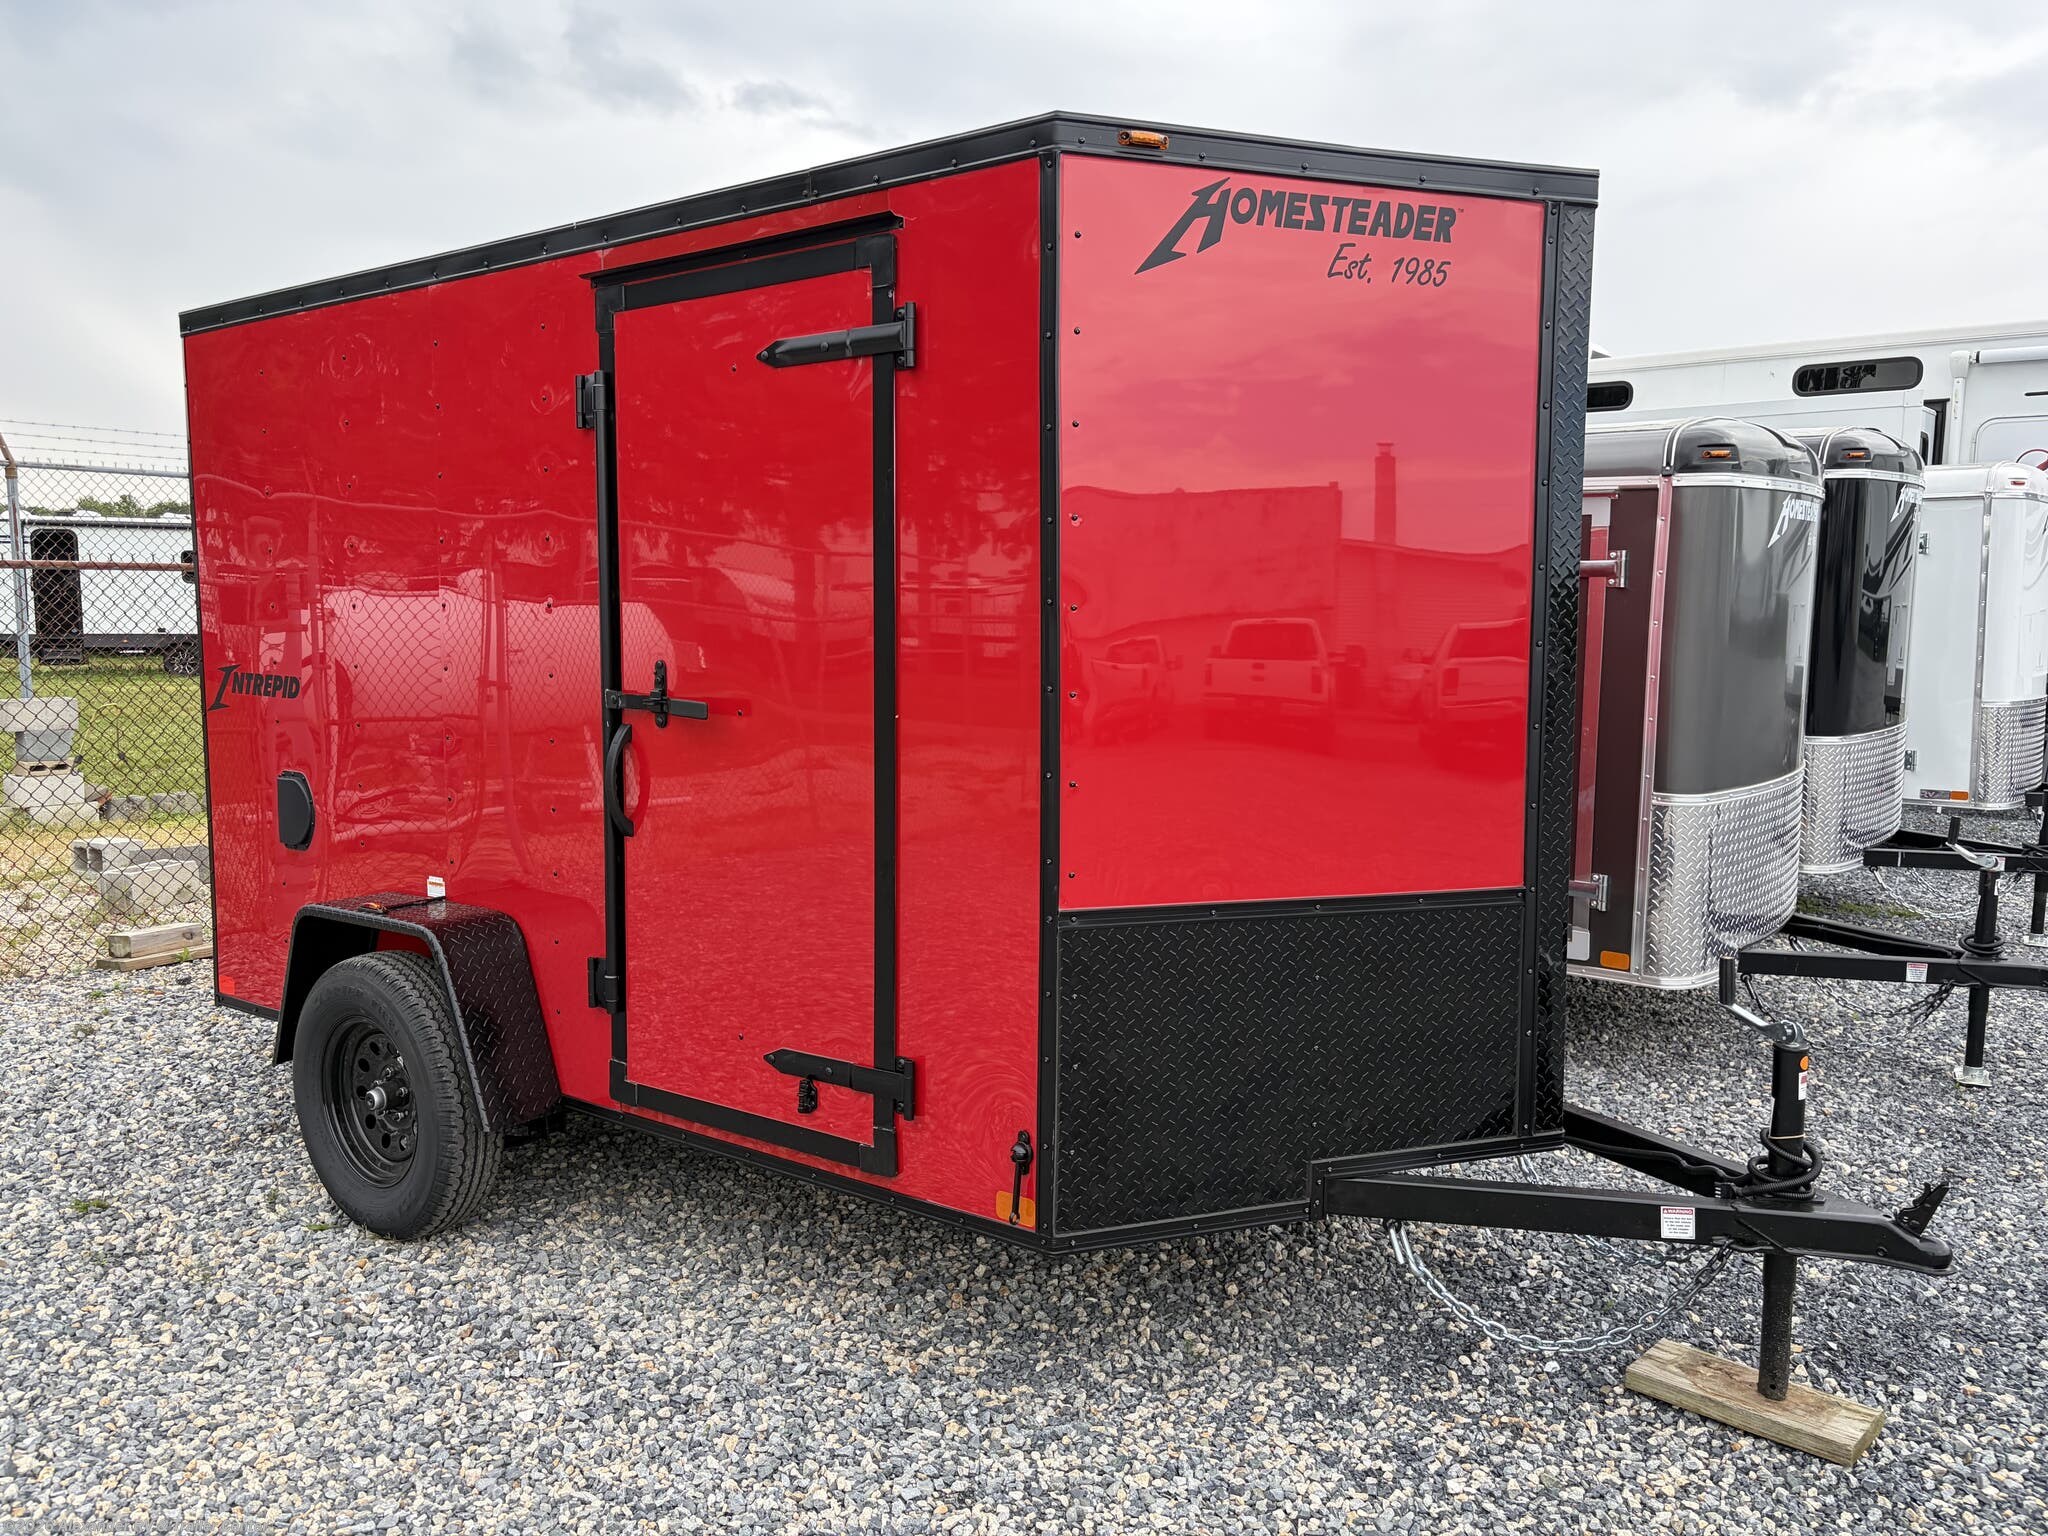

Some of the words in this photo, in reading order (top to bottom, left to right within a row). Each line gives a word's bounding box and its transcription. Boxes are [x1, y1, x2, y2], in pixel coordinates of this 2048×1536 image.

[1327, 243, 1373, 284] Est.
[1392, 257, 1452, 288] 1985
[207, 663, 301, 709] INTREPID
